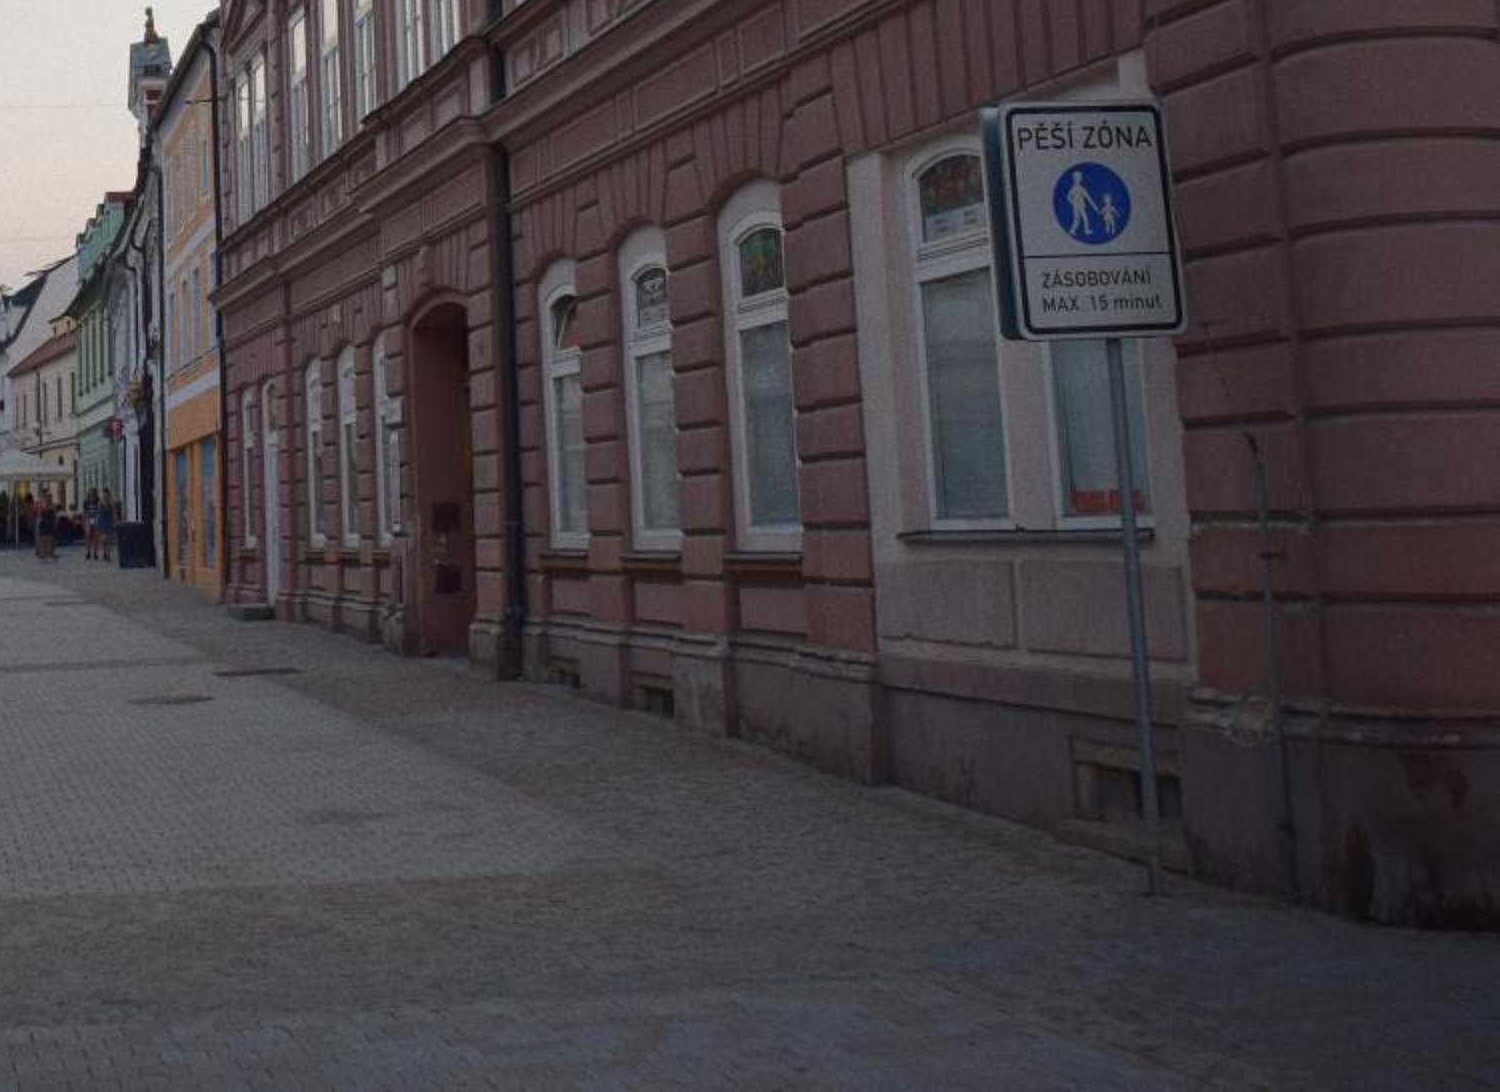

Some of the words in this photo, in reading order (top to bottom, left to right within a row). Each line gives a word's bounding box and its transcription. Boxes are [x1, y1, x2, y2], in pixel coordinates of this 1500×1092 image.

[1018, 120, 1073, 150] PĚŠÍ
[1082, 119, 1152, 149] ZÓNA
[1091, 294, 1108, 311] 15
[1113, 293, 1163, 309] minut
